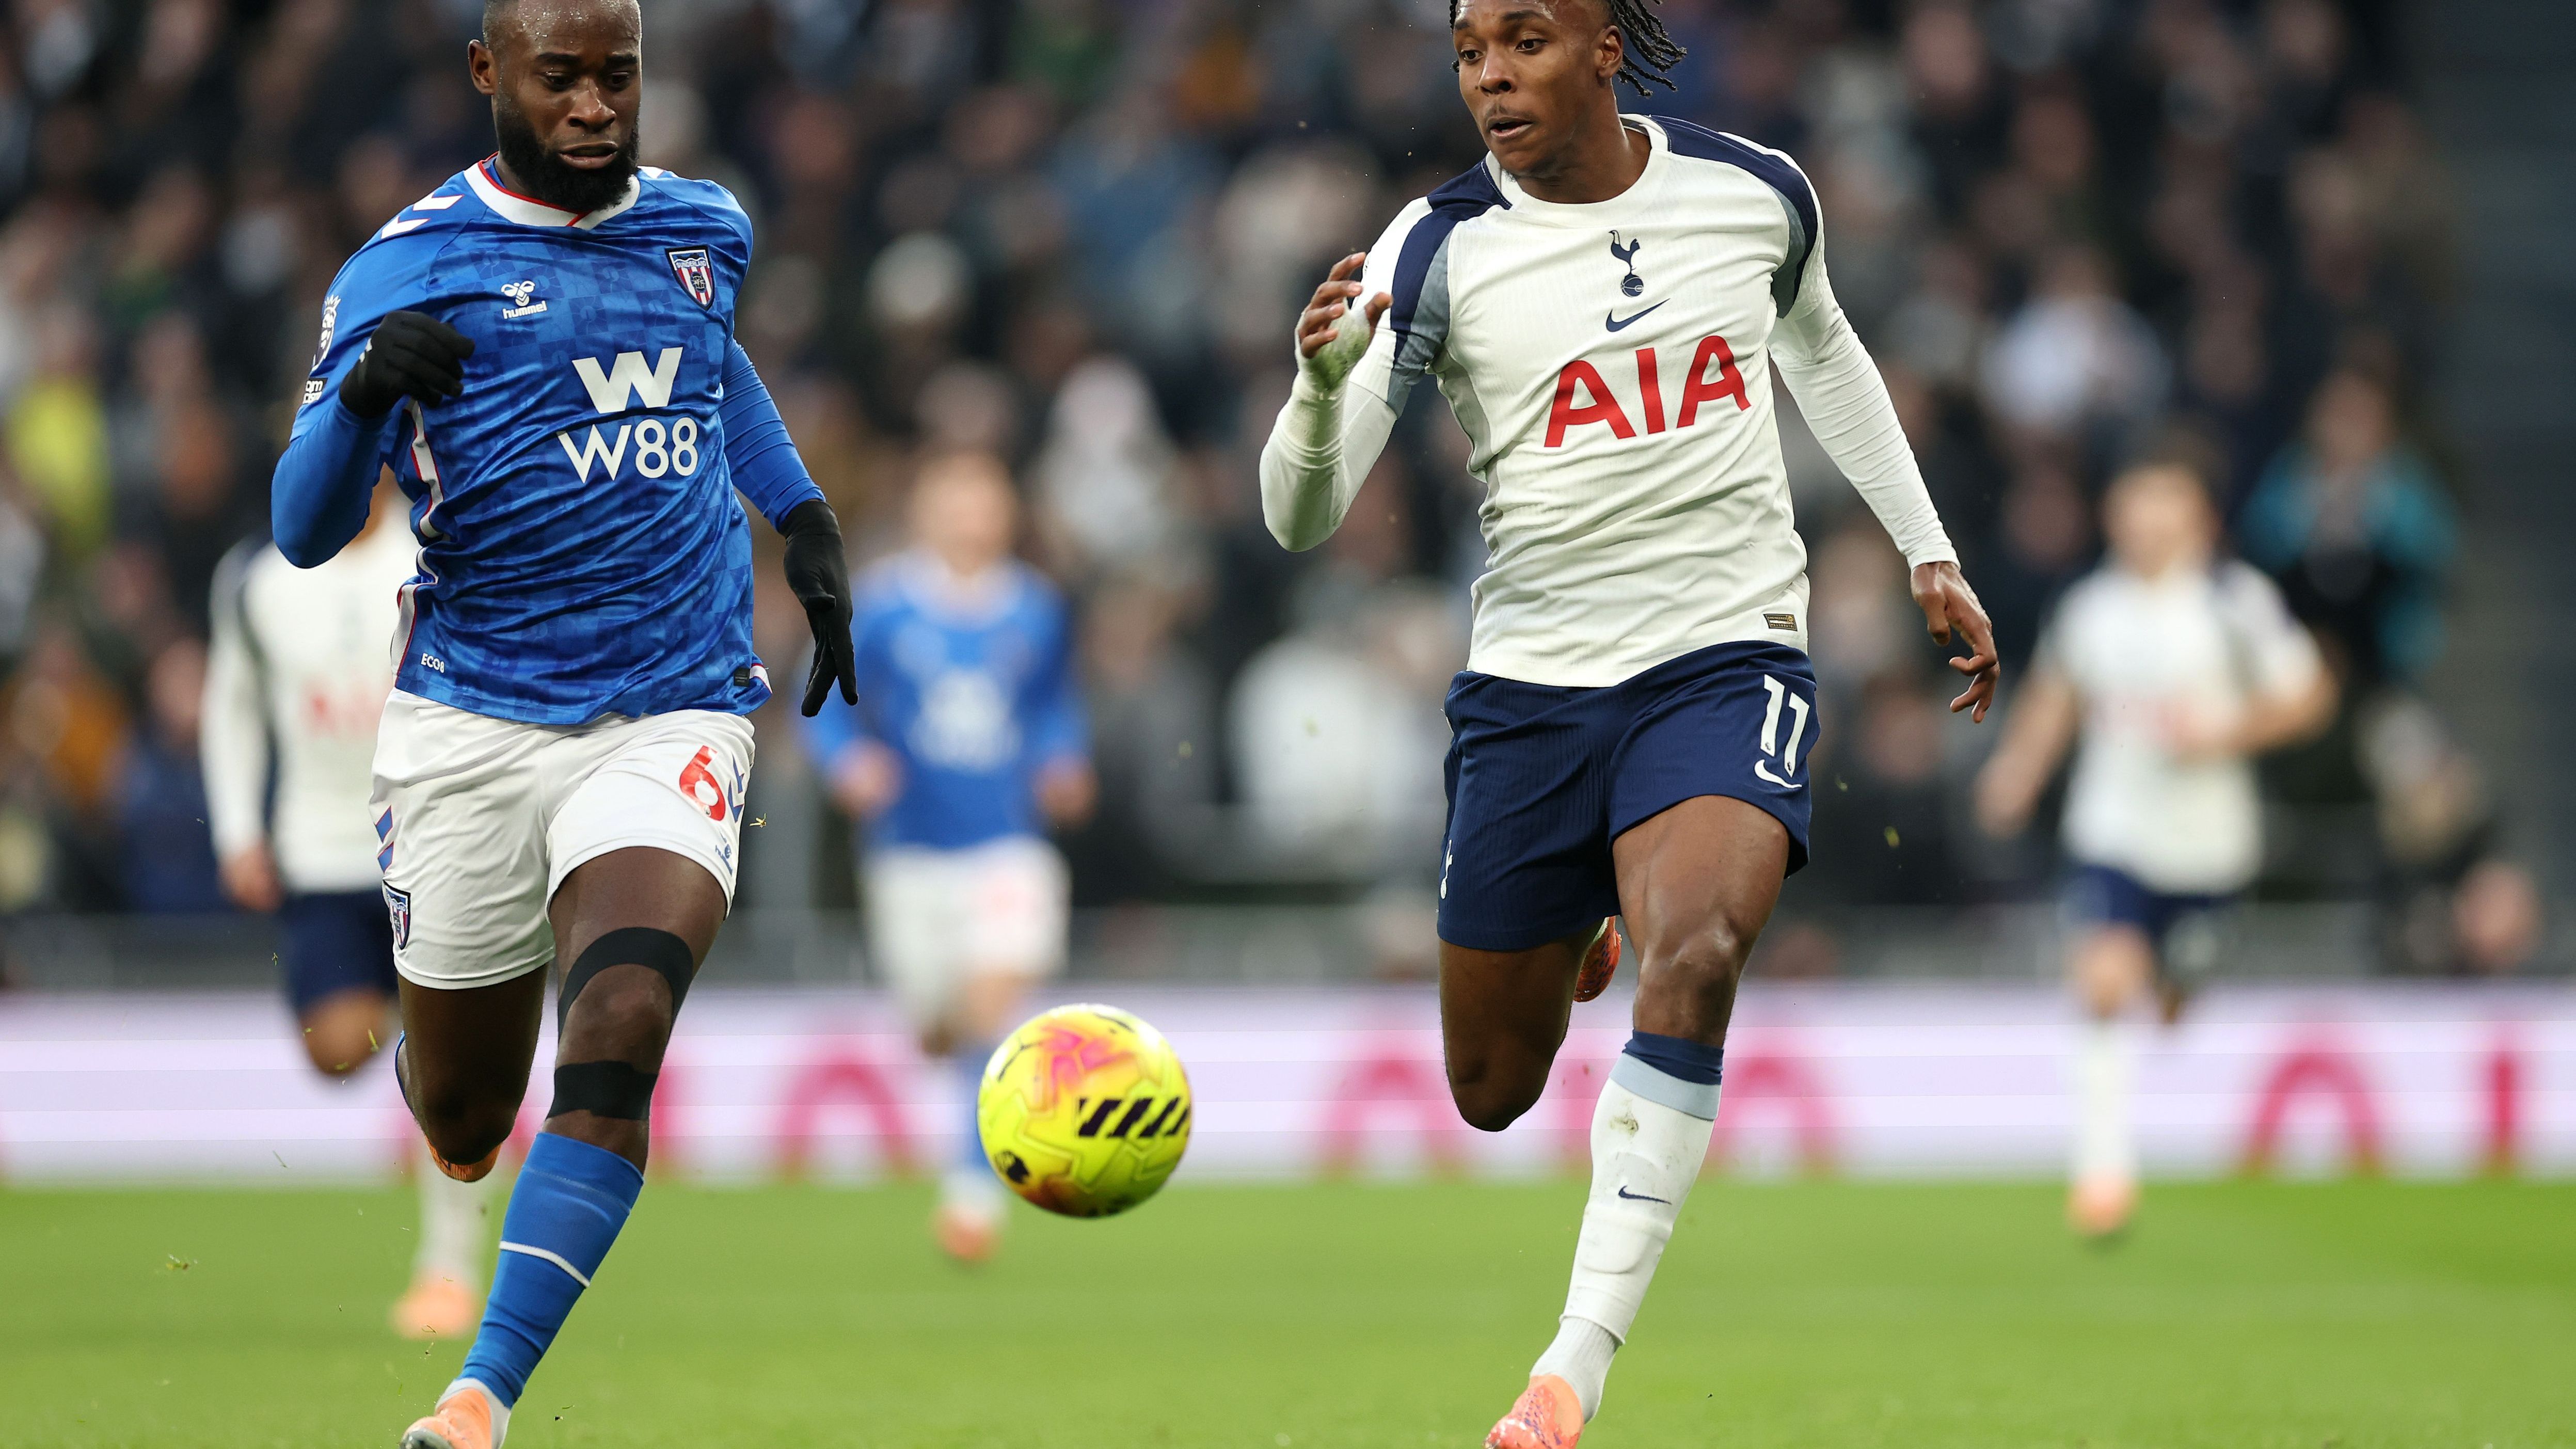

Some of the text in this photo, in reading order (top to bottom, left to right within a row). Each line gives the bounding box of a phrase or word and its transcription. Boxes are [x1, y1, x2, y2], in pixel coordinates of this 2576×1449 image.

[503, 300, 547, 319] hummel
[572, 347, 683, 413] W
[1544, 335, 1752, 448] AIA
[557, 417, 698, 484] W88
[1760, 674, 1809, 778] 11
[679, 745, 726, 821] 6
